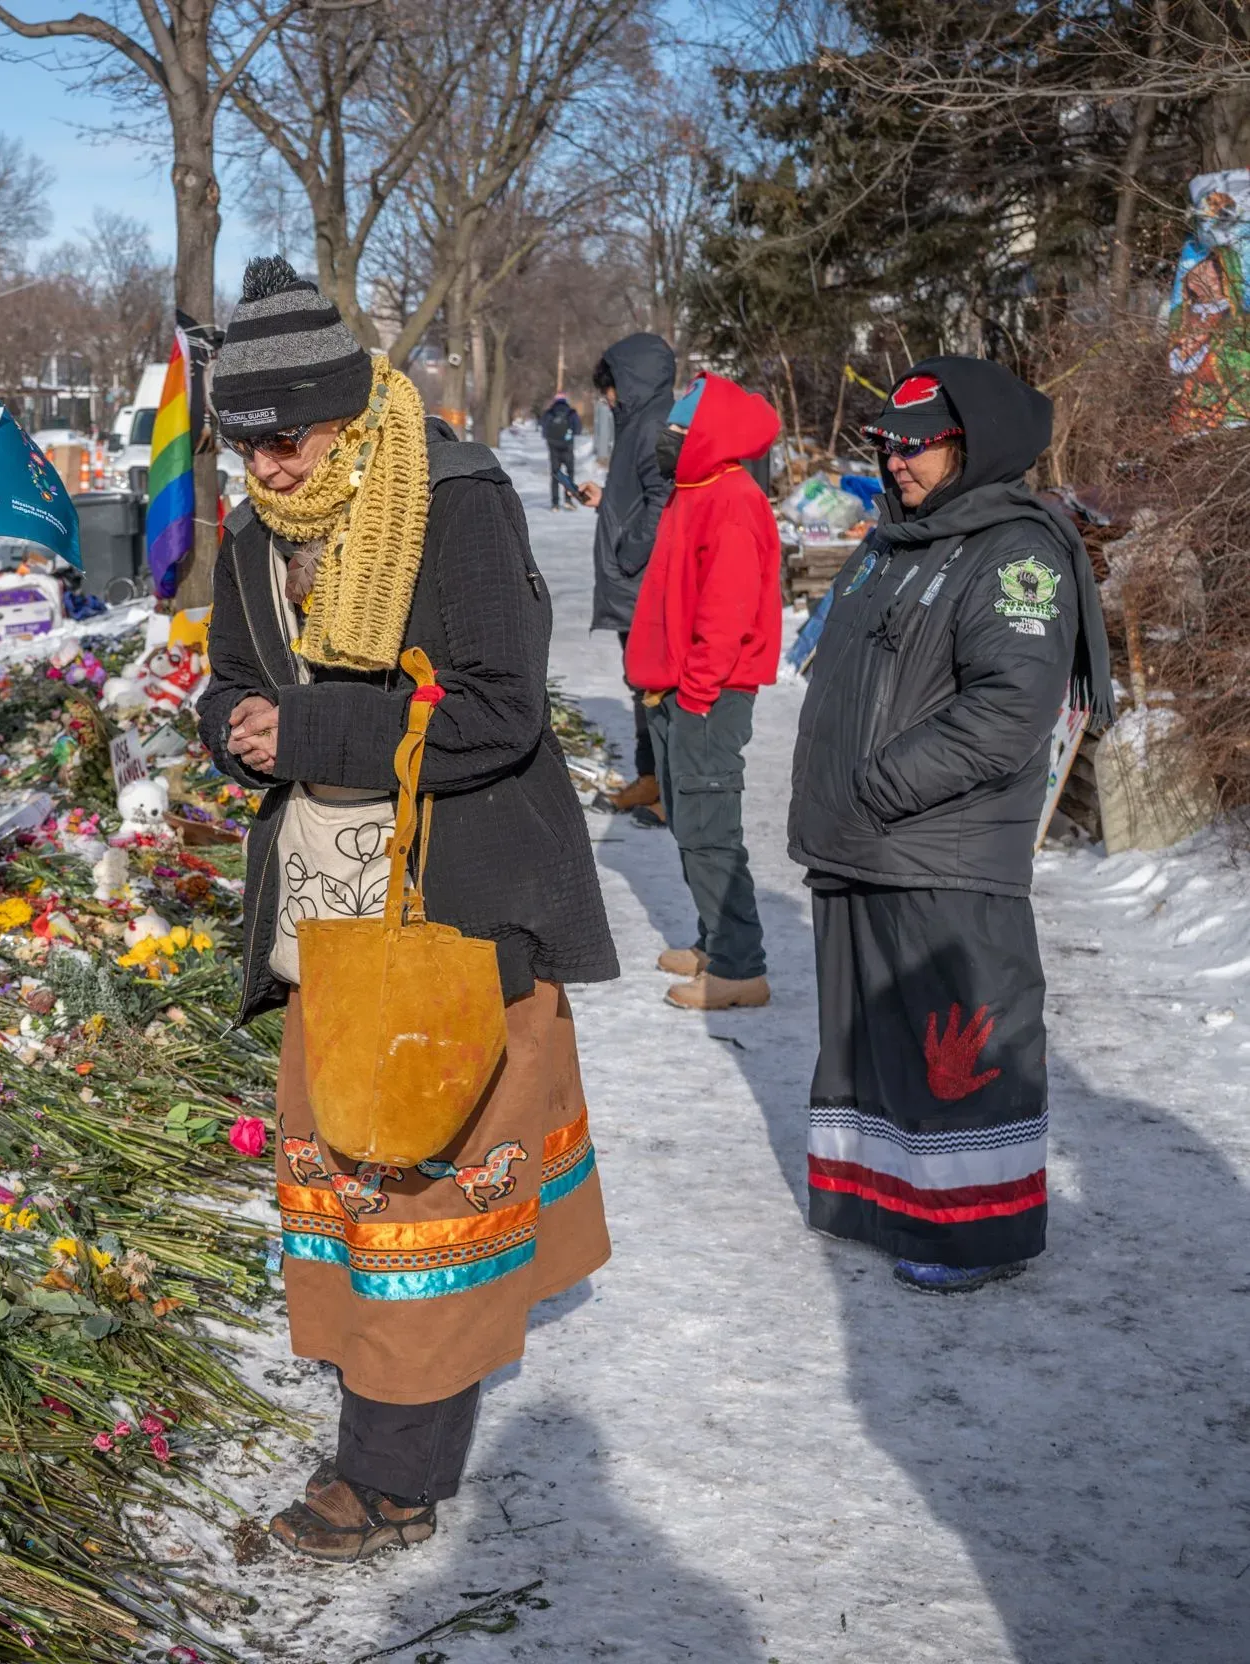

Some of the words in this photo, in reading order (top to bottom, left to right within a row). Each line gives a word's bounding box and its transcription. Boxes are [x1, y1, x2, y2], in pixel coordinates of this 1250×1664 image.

[248, 410, 269, 420] GUARD
[12, 499, 36, 512] Missing
[36, 507, 47, 515] and
[1008, 621, 1034, 630] NORTH
[114, 739, 130, 767] JOSE
